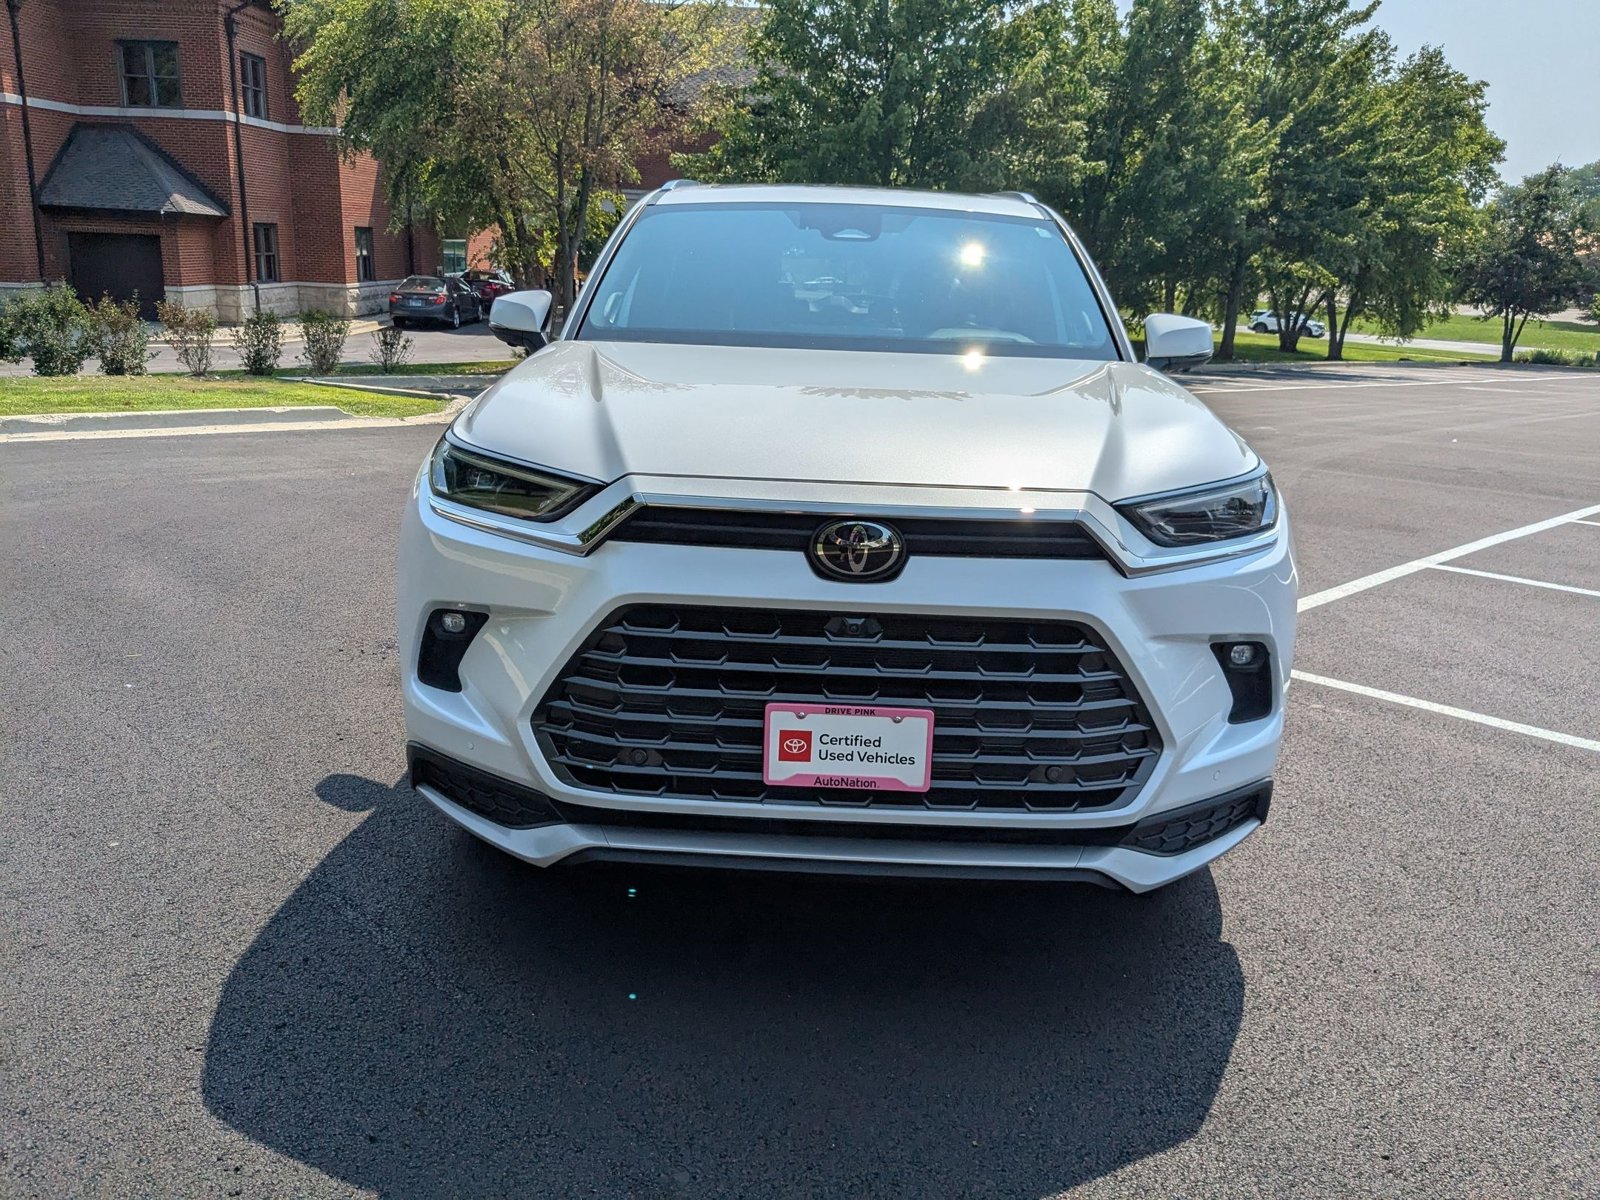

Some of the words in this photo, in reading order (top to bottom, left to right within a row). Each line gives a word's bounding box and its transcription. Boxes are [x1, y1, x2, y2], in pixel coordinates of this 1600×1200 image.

[825, 707, 852, 715] DRIVE
[855, 708, 876, 716] PINK
[819, 733, 882, 748] Certified
[818, 749, 854, 762] Used
[857, 751, 916, 766] Vehicles
